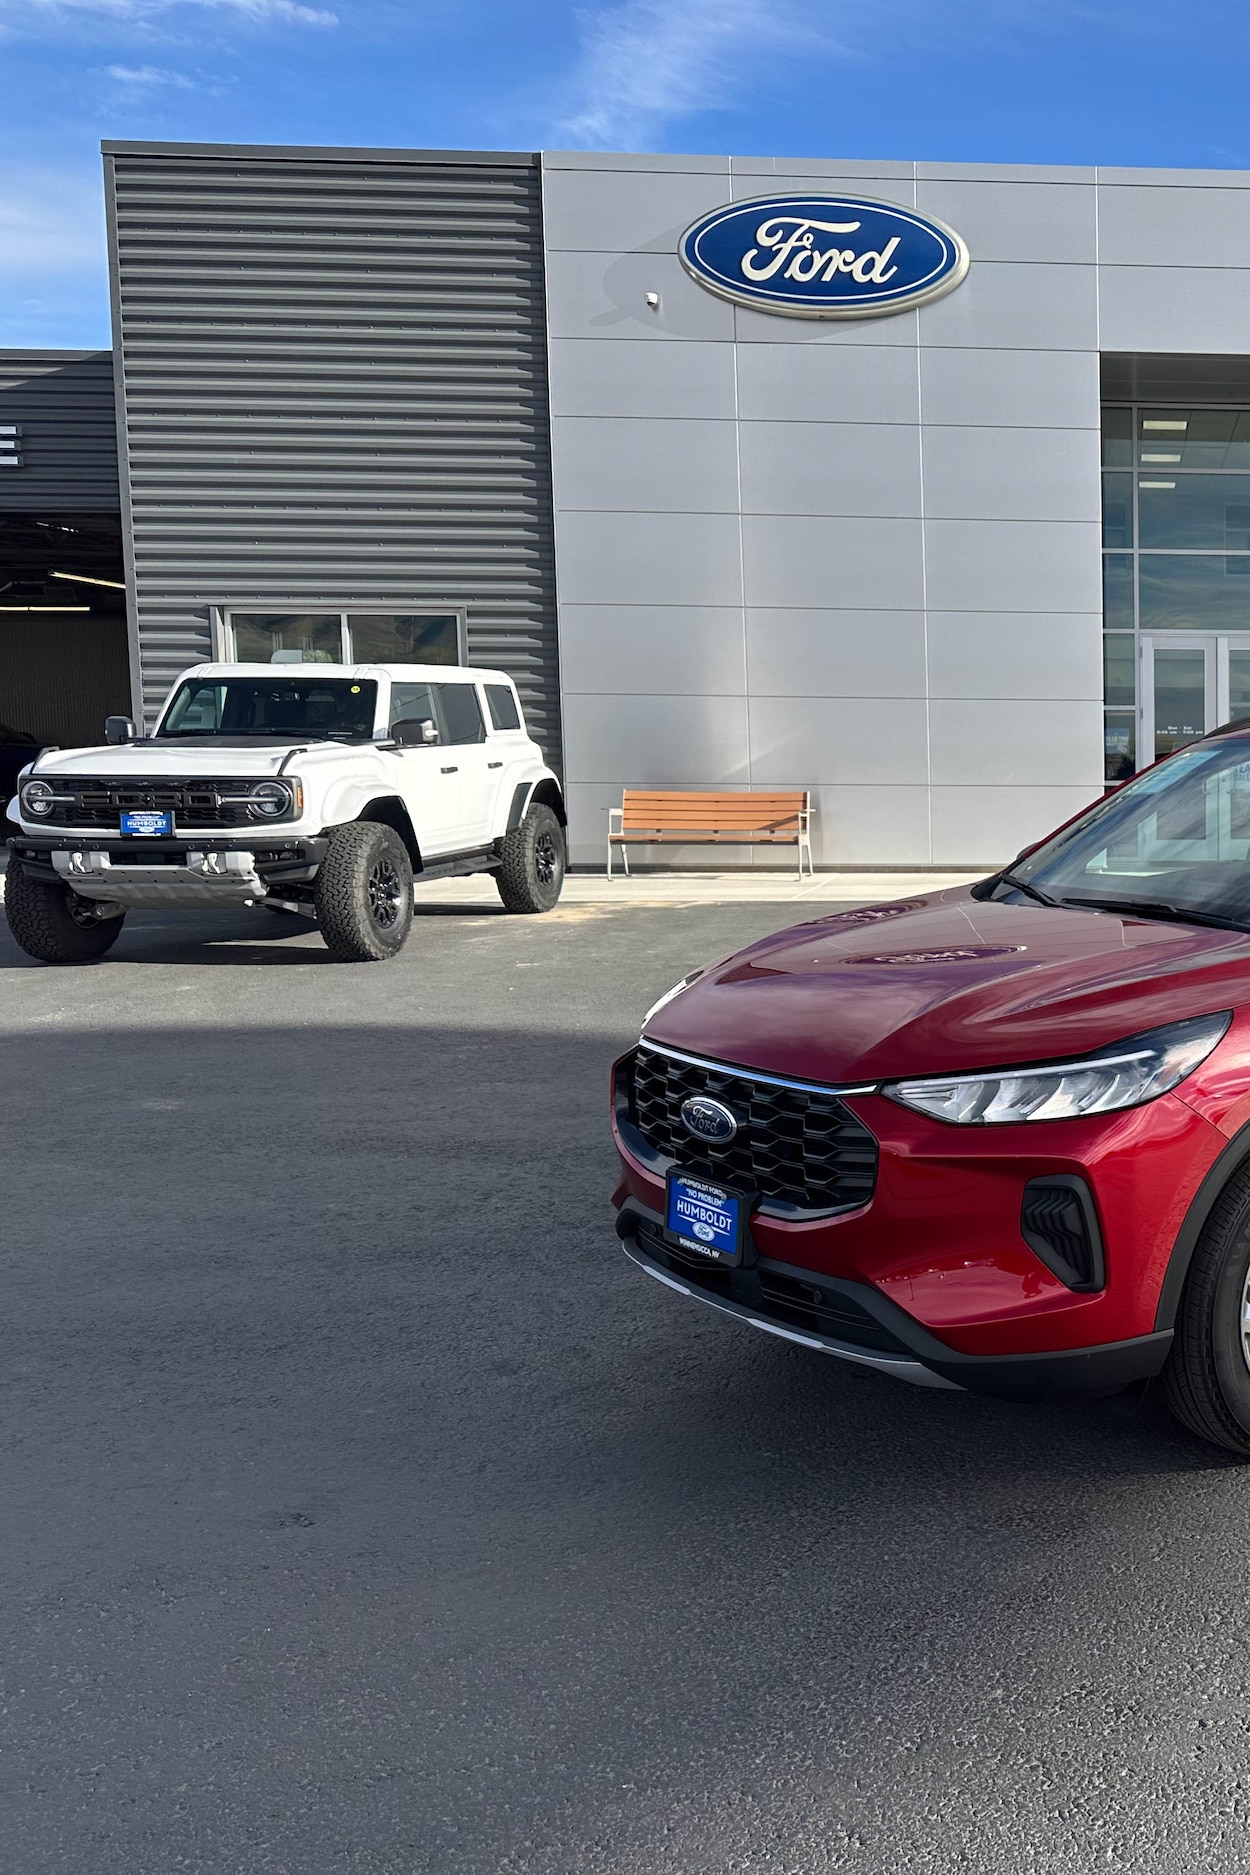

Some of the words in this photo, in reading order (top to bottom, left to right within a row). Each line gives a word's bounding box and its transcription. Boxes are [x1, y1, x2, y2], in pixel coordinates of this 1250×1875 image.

[741, 217, 902, 284] Ford
[690, 1105, 721, 1134] Ford
[676, 1199, 732, 1231] HUMBOLDT
